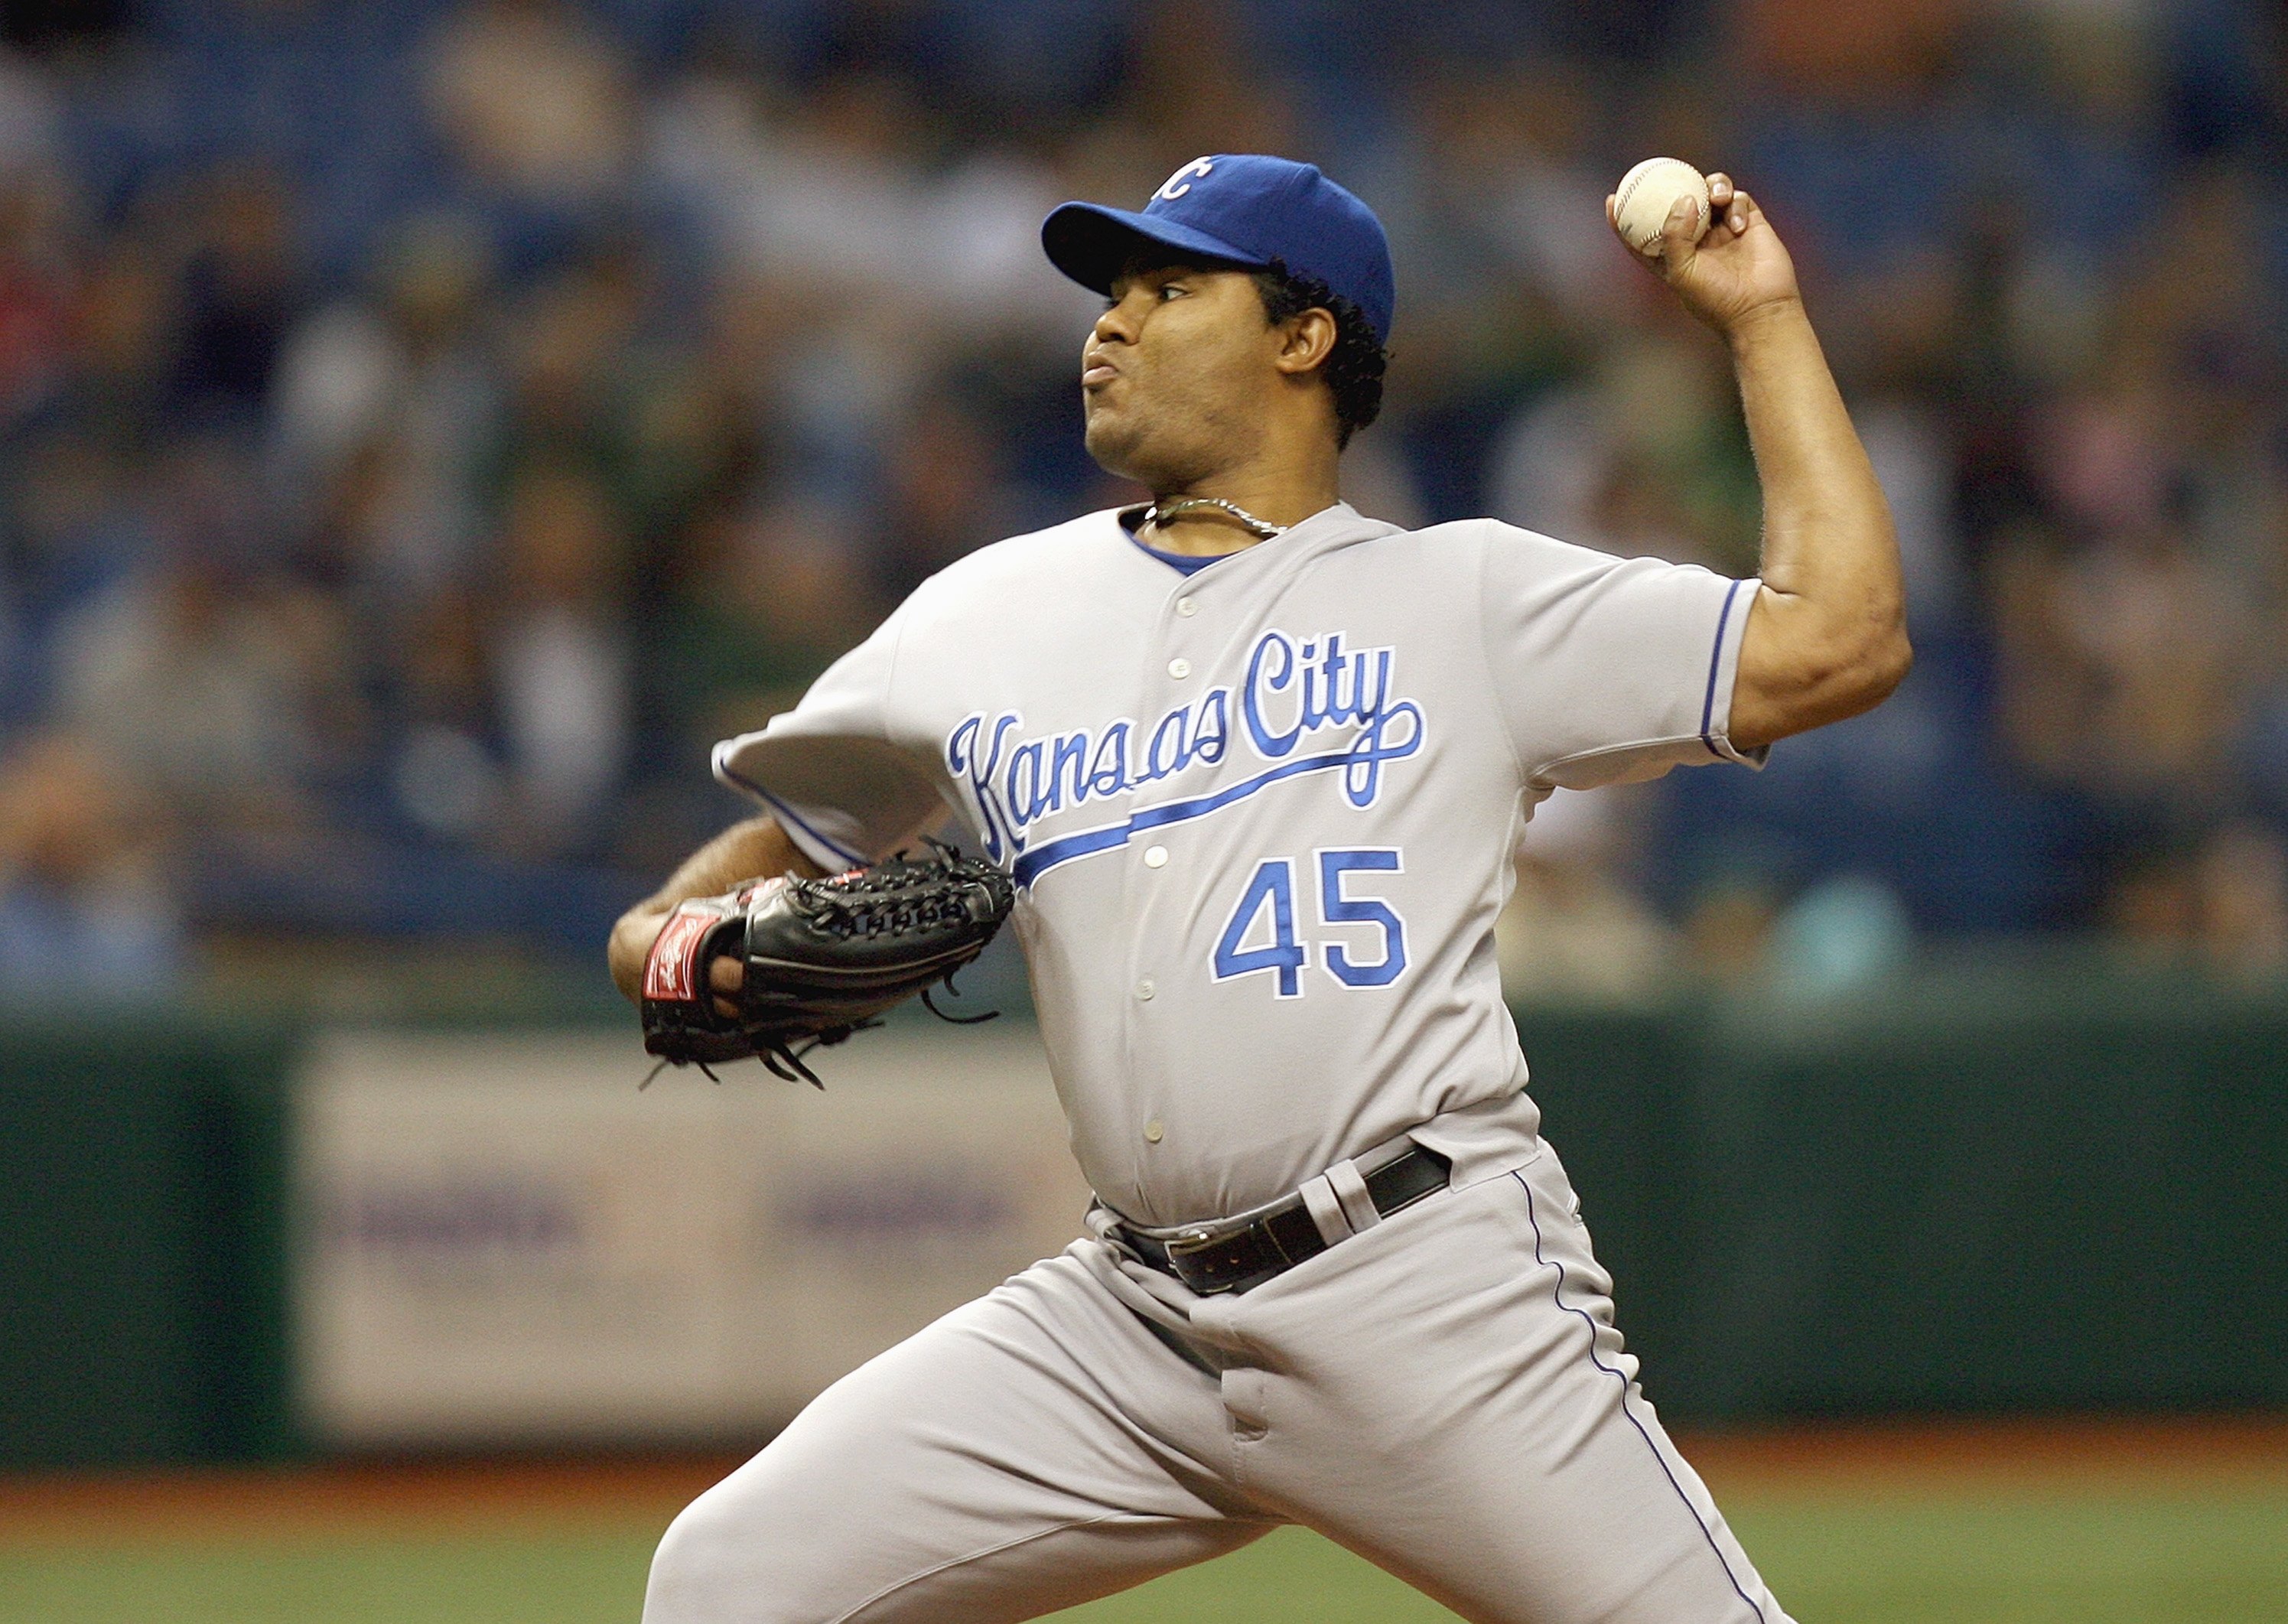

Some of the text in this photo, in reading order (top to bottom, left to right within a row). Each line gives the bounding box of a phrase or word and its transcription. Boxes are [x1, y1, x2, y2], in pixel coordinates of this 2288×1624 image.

[945, 626, 1427, 867] Kansas City
[1209, 846, 1412, 1001] 45
